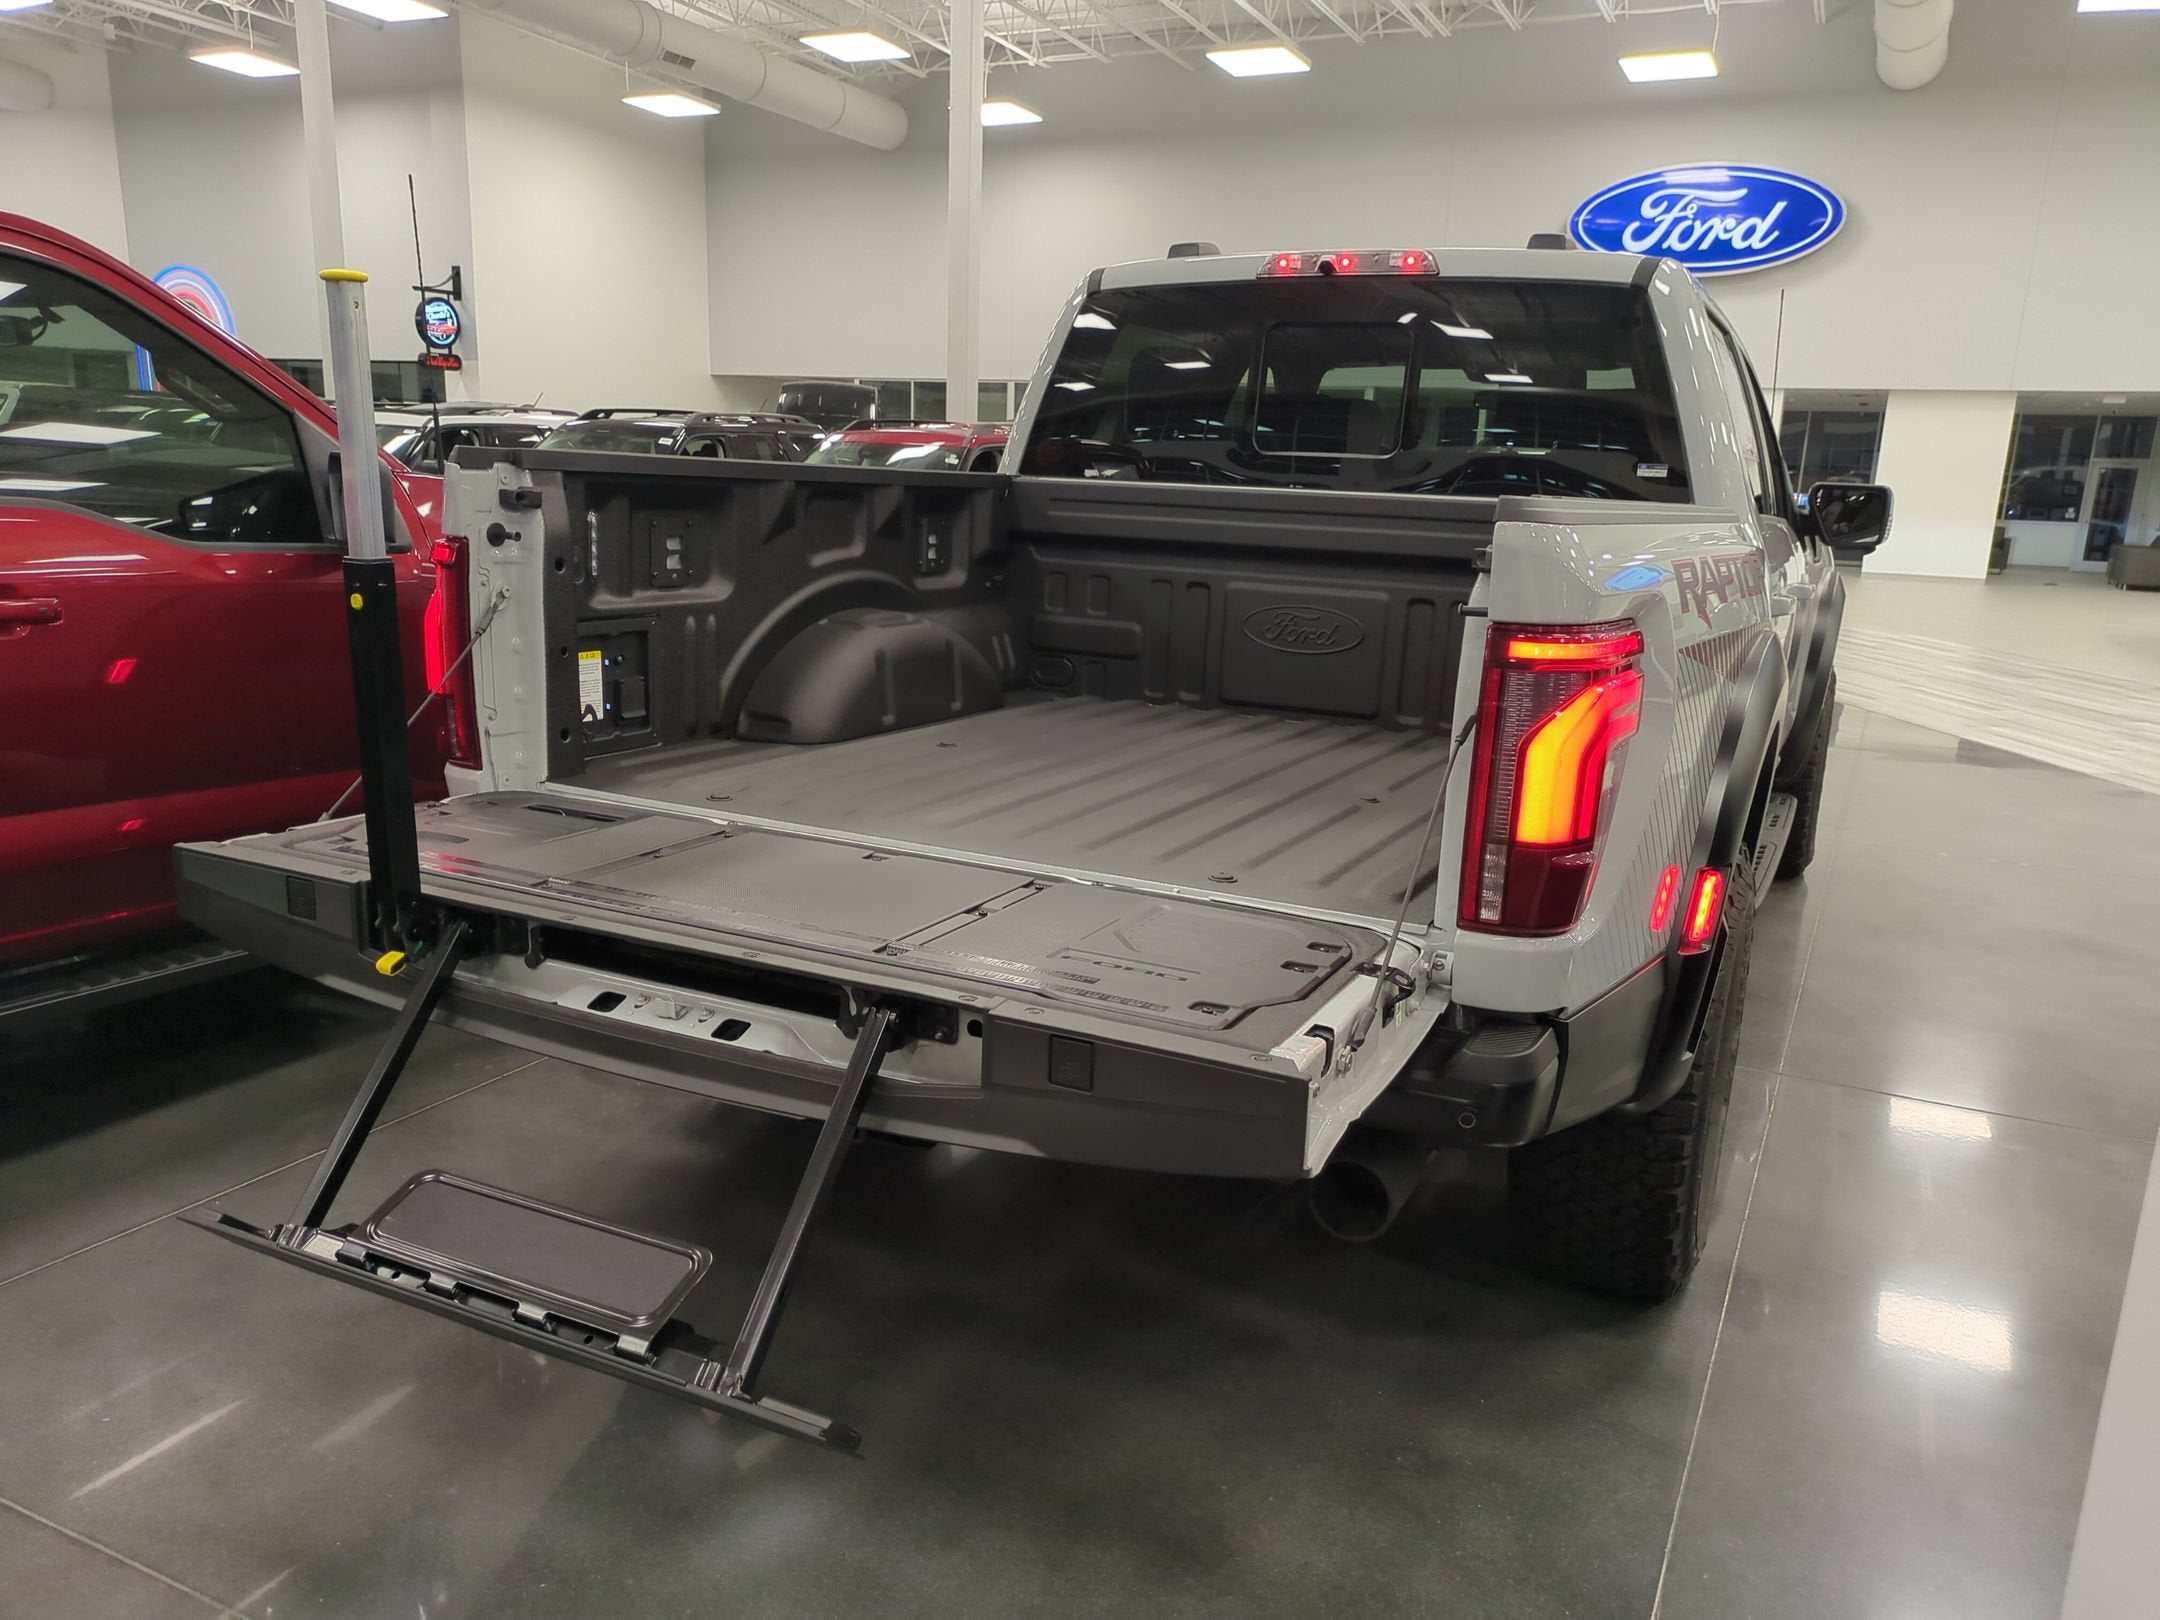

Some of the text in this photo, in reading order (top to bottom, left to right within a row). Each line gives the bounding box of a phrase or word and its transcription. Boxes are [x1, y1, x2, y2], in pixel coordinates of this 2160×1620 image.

[1622, 188, 1787, 252] Ford
[1670, 550, 1763, 631] RAPTO
[1264, 610, 1340, 646] Ford
